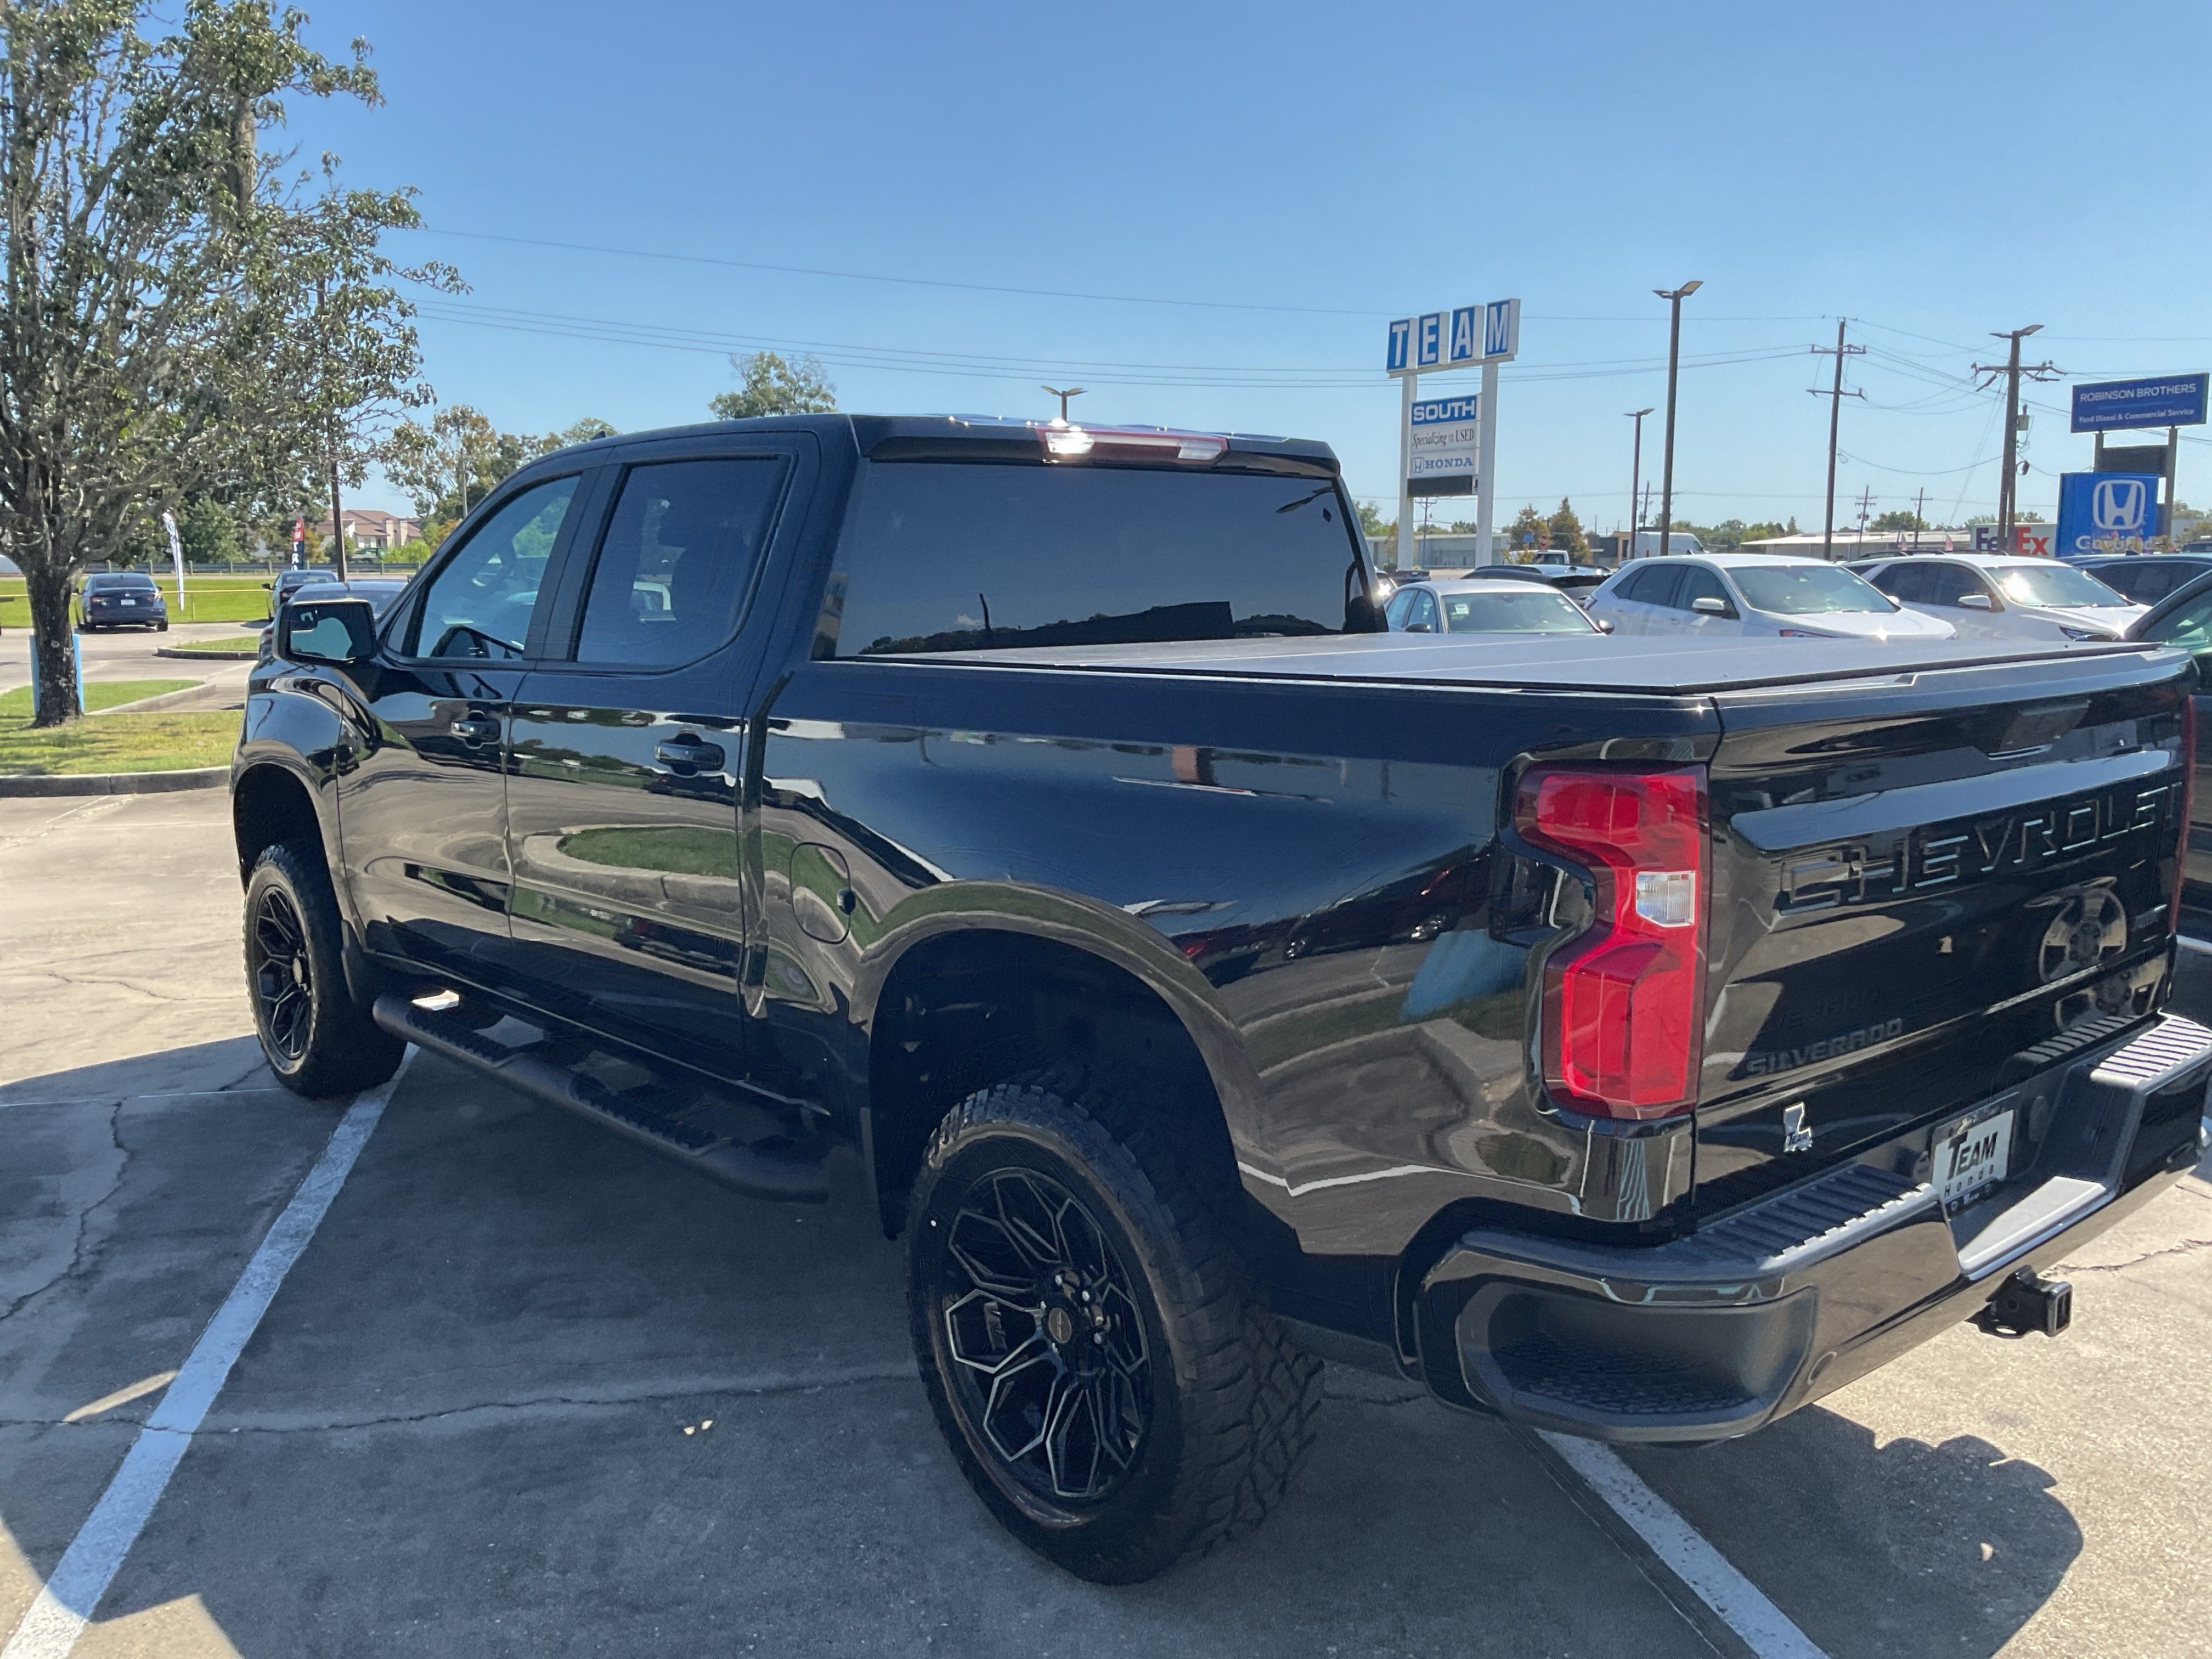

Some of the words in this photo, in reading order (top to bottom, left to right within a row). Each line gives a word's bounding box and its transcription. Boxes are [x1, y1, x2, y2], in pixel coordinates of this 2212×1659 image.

[1392, 303, 1509, 367] TEAM
[2080, 388, 2135, 403] ROBINSON
[2136, 383, 2197, 398] BROTHERS
[1413, 400, 1475, 422] SOUTH
[2096, 413, 2116, 422] Diesel
[2124, 409, 2166, 420] Commercial
[2168, 408, 2194, 417] Service
[1412, 432, 1447, 449] Specializing
[1448, 430, 1454, 443] in
[1455, 428, 1475, 443] USED
[1425, 457, 1474, 470] HONDA
[1779, 781, 2183, 916] CHEVROLET
[1746, 1017, 1904, 1076] SILVERADO
[1946, 1131, 1999, 1181] TEAM
[1944, 1164, 1994, 1200] Honda
